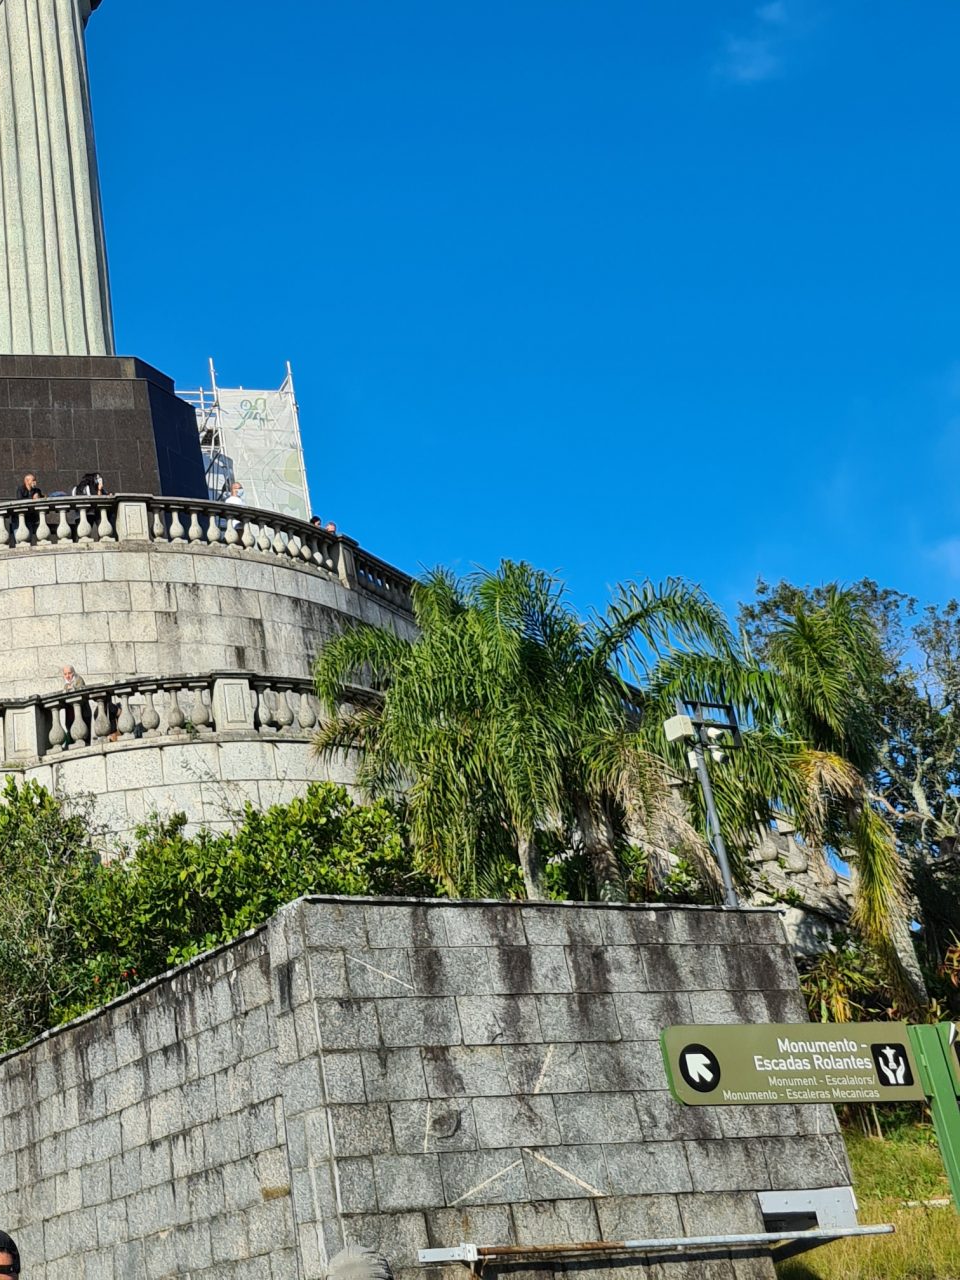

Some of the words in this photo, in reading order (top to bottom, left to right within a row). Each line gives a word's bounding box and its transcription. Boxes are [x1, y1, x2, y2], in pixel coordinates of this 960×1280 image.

[777, 1038, 857, 1053] Monumento
[754, 1055, 811, 1071] Escadas
[813, 1054, 872, 1070] Rolantes
[768, 1075, 817, 1087] Monument
[825, 1074, 876, 1086] Escalators/
[723, 1089, 777, 1101] Monumento
[786, 1088, 831, 1100] Escaleras
